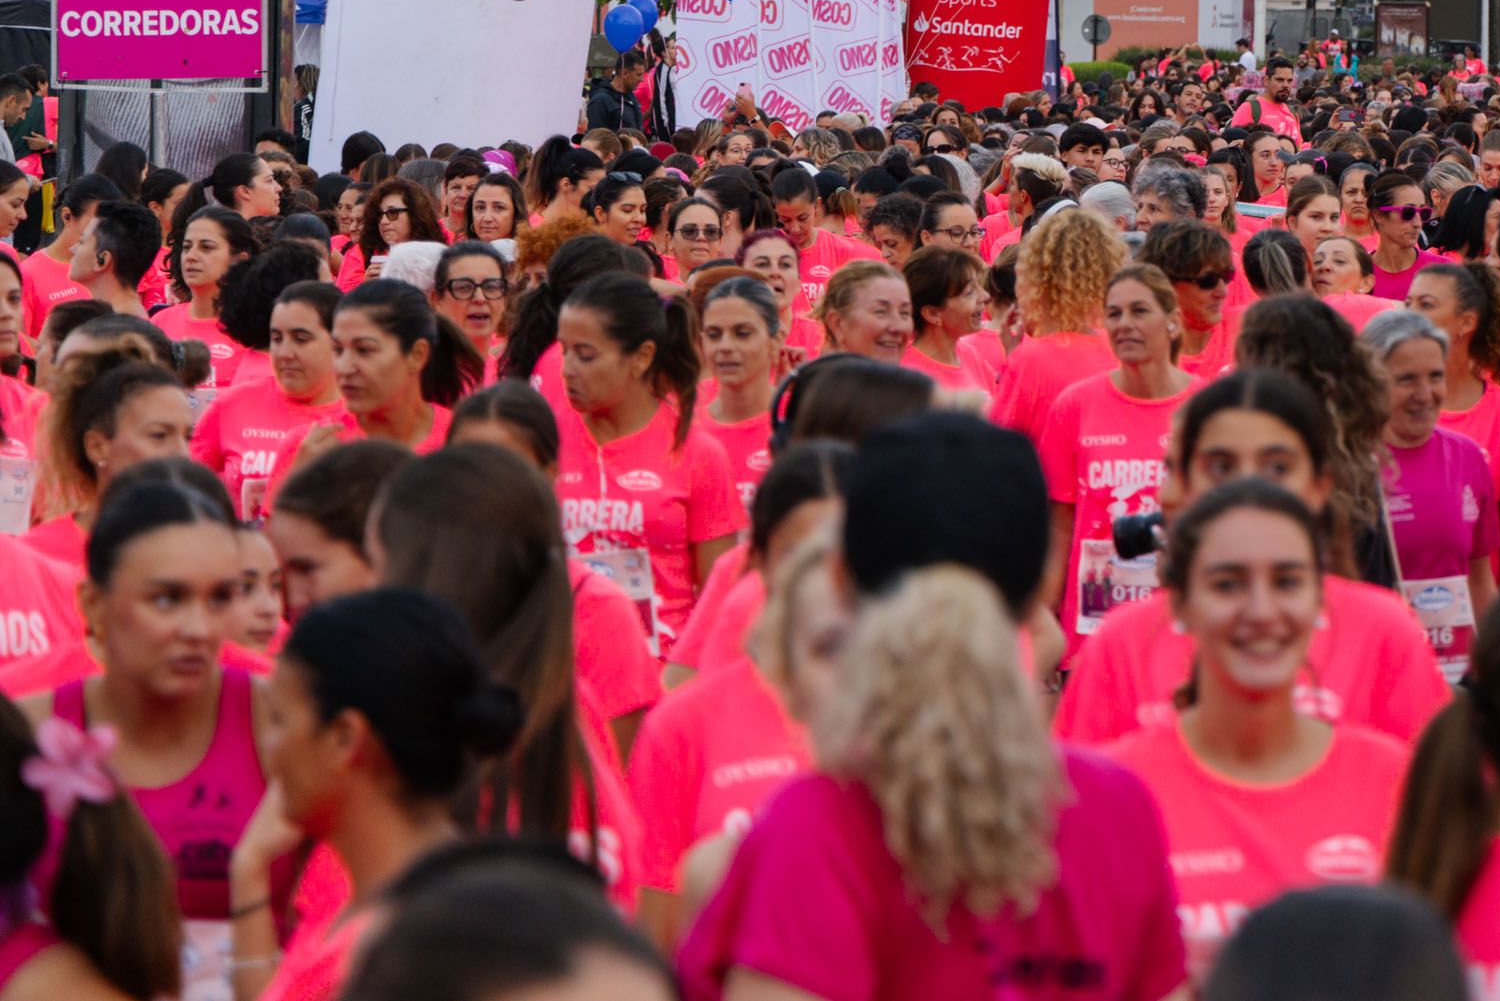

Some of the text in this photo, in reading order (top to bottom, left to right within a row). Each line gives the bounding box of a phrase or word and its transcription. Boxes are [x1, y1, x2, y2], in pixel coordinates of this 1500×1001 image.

[61, 8, 259, 37] CORREDORAS
[931, 17, 1023, 39] Santander
[49, 287, 78, 300] OYSHO
[1112, 585, 1152, 602] 016
[1425, 627, 1453, 645] 16
